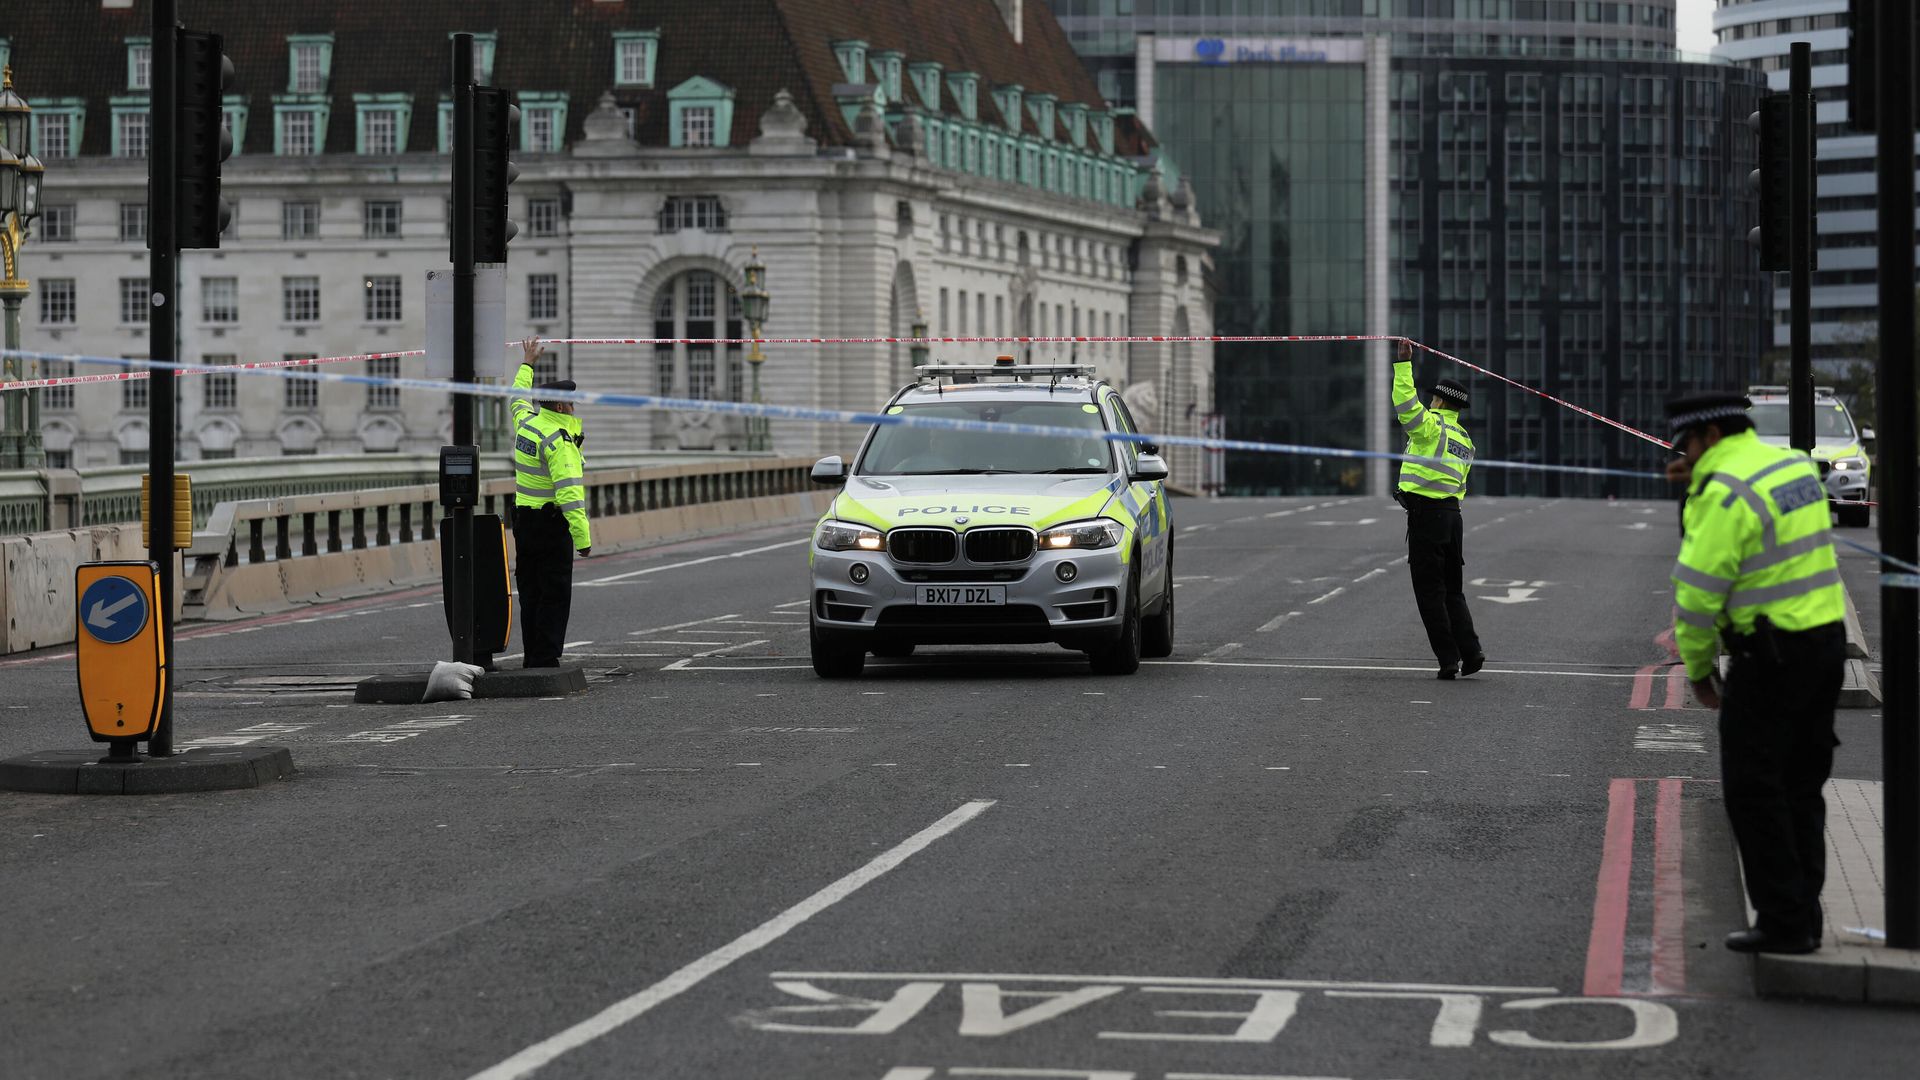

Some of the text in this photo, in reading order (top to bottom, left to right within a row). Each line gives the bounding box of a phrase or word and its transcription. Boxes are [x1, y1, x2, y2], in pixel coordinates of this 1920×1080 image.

[897, 504, 1031, 517] POLICE
[926, 588, 996, 604] BX17 DZL
[745, 980, 1680, 1051] CLEAR
